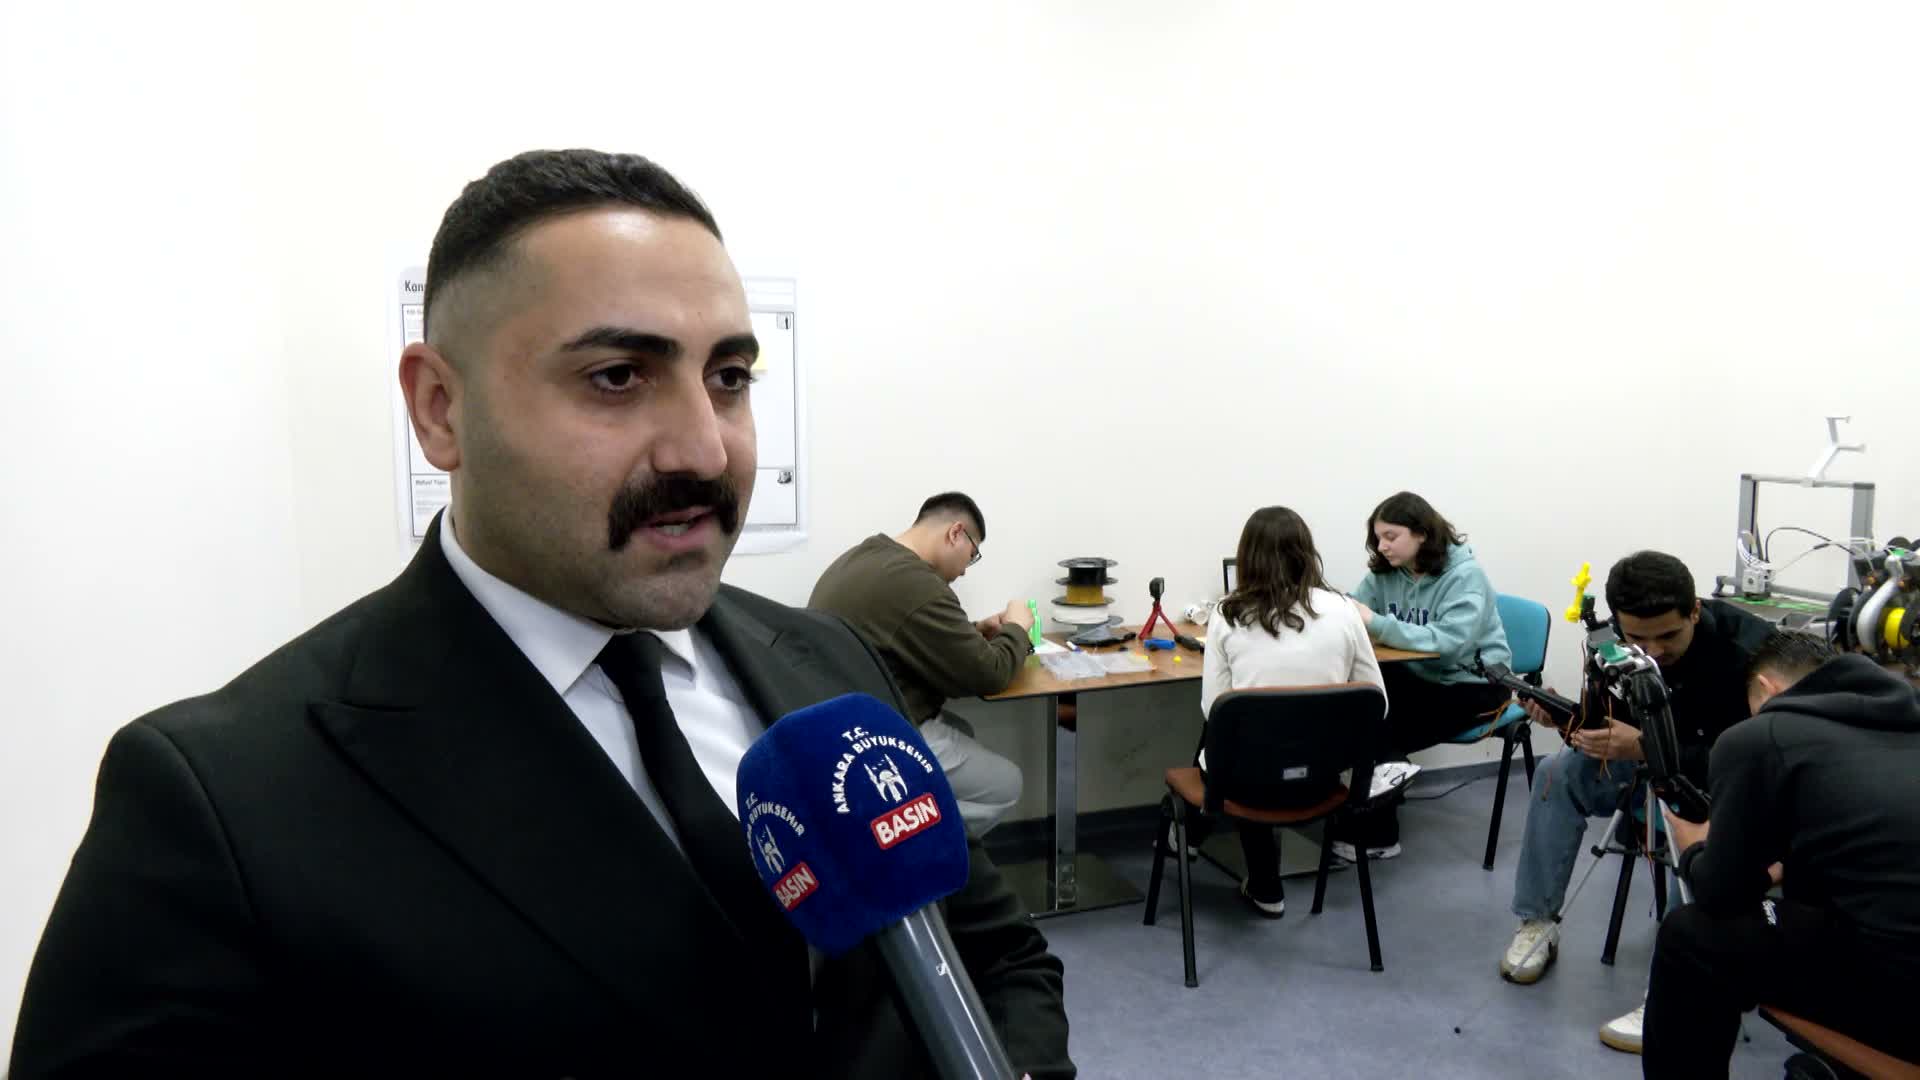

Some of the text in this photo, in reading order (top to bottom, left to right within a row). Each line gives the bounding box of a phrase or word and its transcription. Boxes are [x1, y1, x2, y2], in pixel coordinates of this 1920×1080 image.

[404, 279, 426, 292] Kon
[832, 752, 856, 814] ANKARA
[875, 797, 938, 845] BASIN
